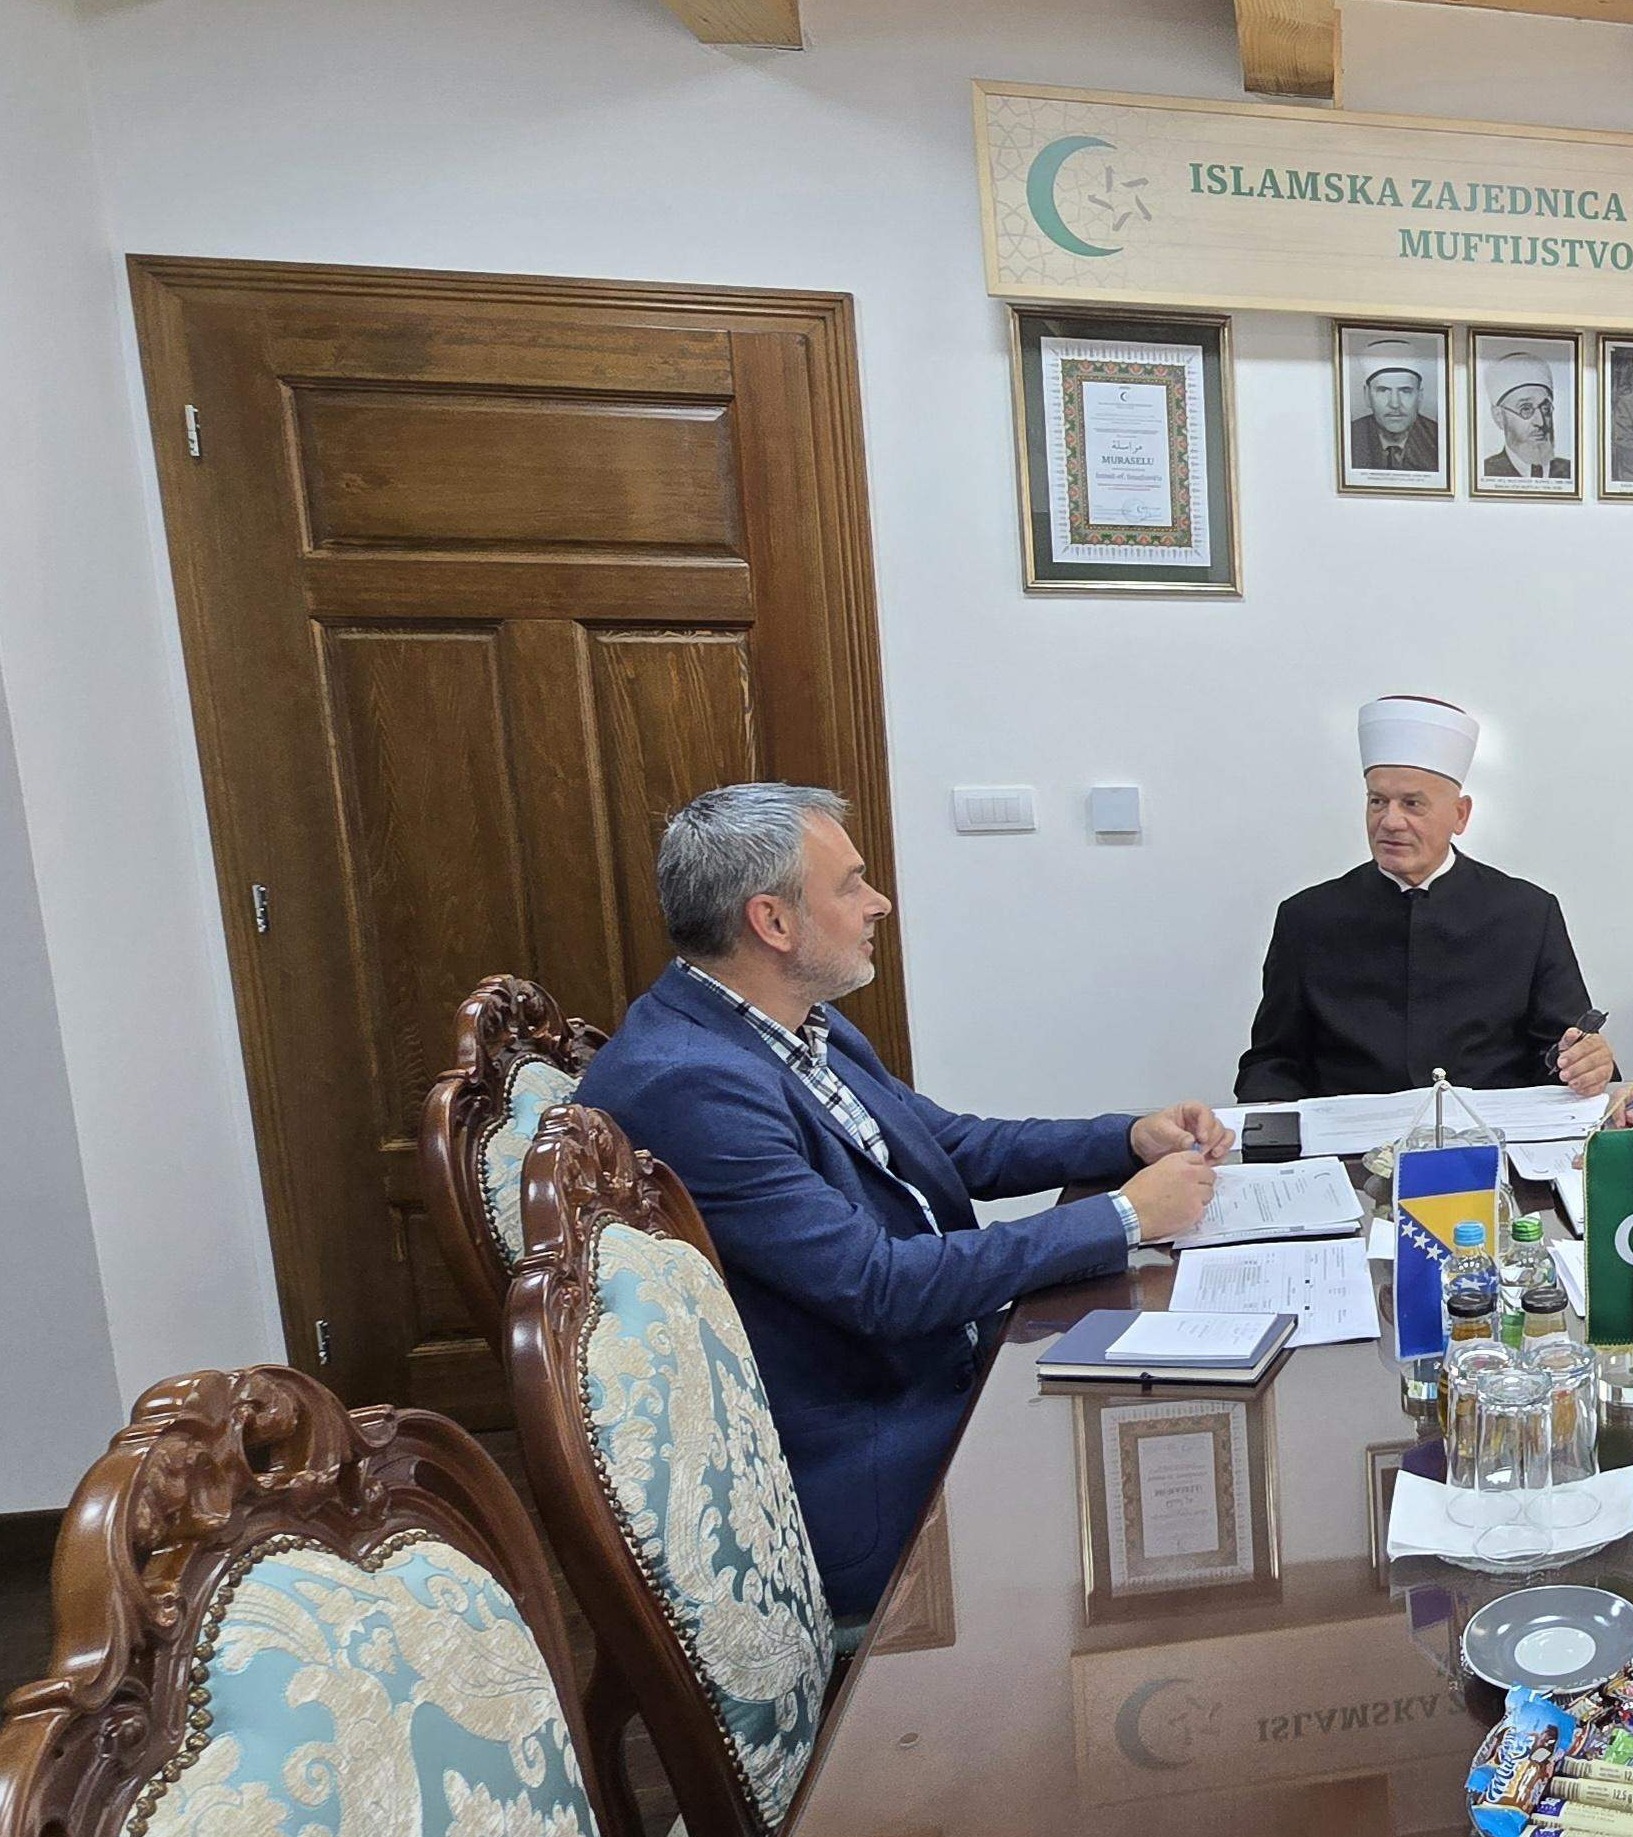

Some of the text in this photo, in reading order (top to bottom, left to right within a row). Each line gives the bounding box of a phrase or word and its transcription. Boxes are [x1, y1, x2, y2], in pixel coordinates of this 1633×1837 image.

[1189, 163, 1403, 207] ISLAMSKA
[1411, 178, 1627, 222] ZAJEDNICA
[1399, 229, 1633, 271] MUFTIJSTVO
[1101, 455, 1154, 466] MURASELU
